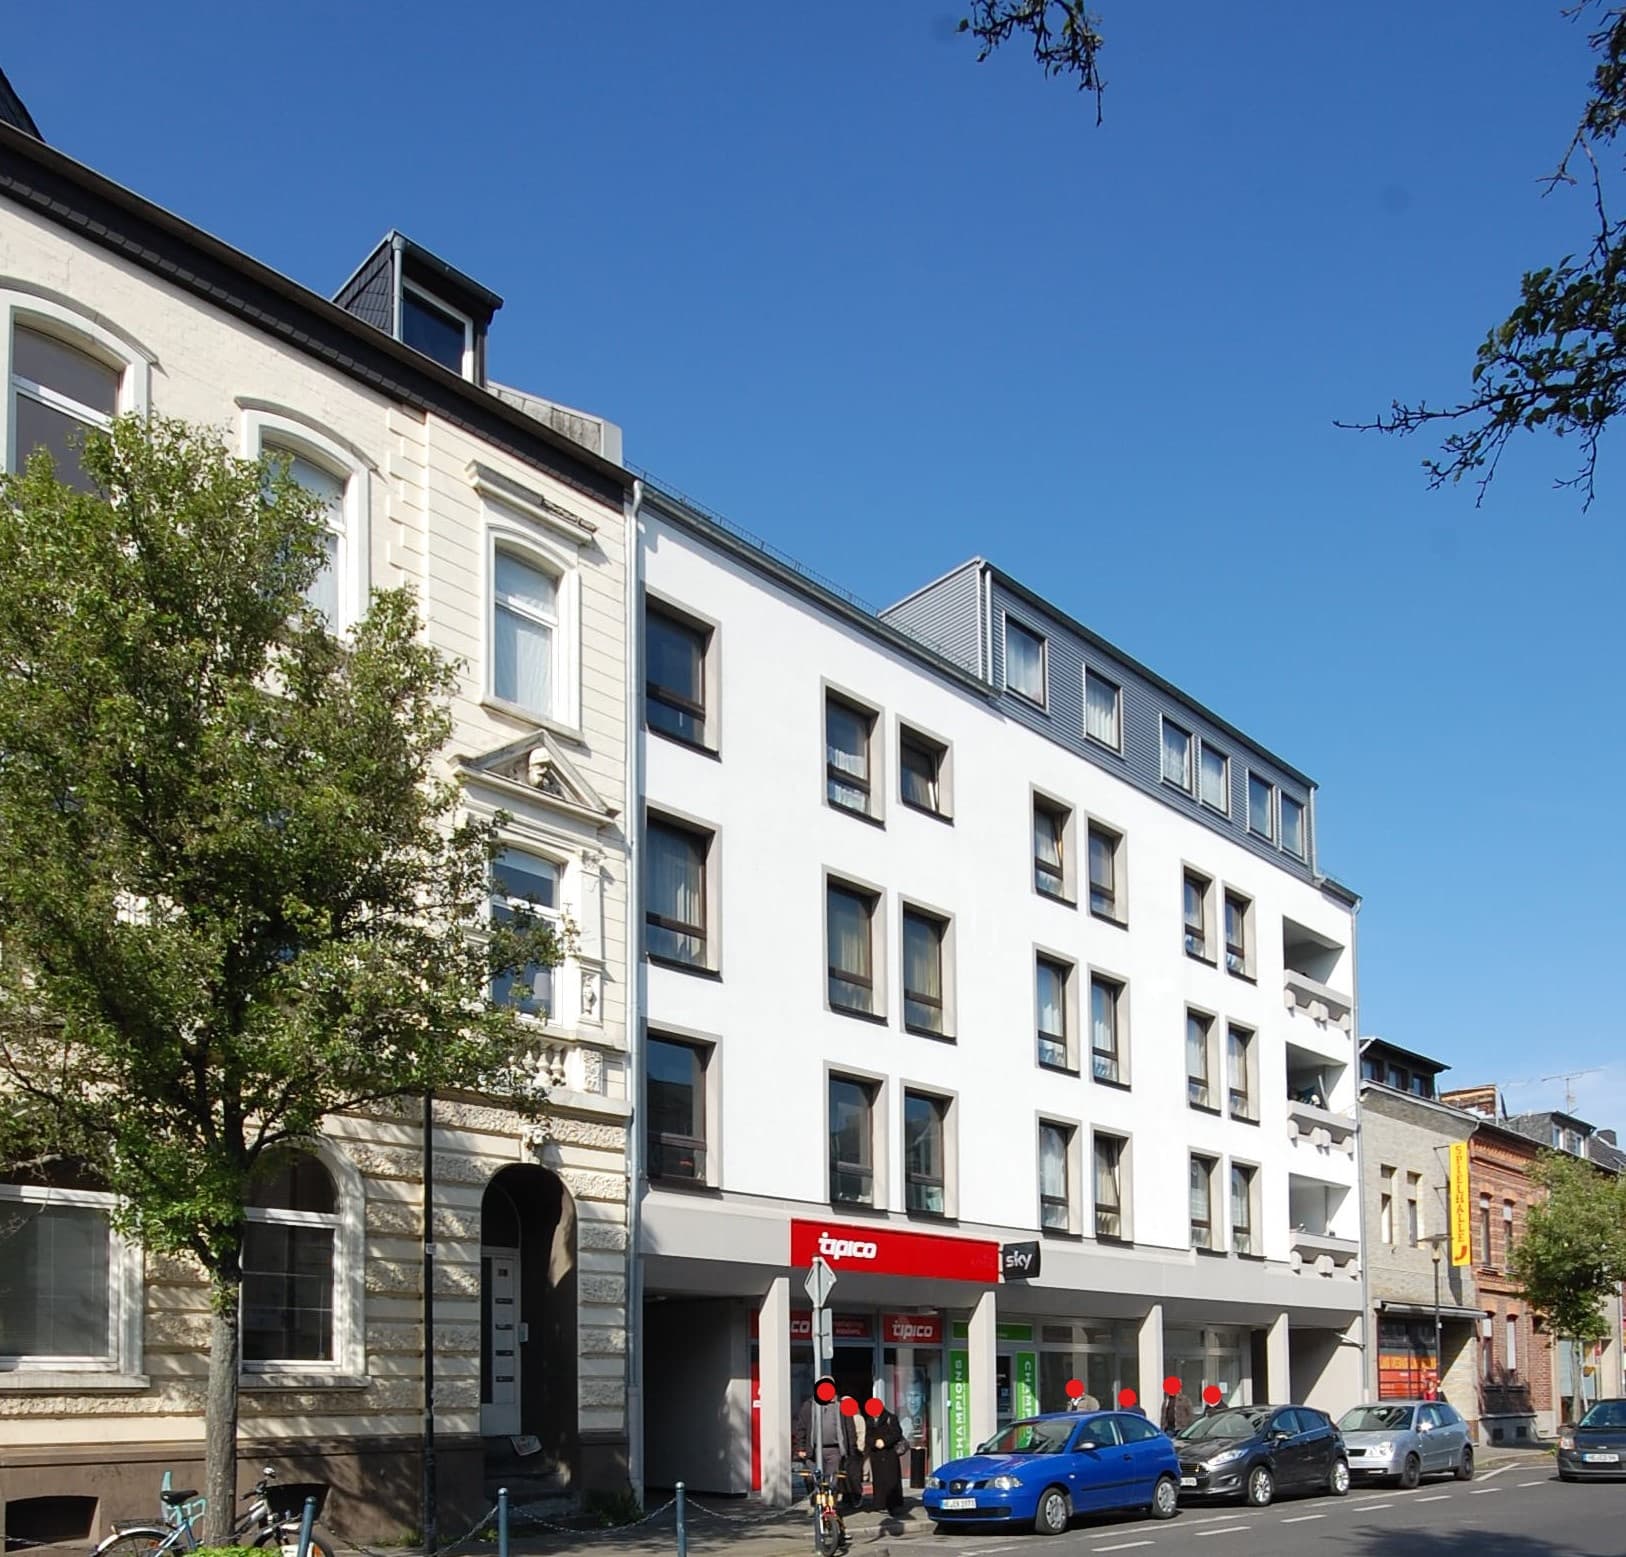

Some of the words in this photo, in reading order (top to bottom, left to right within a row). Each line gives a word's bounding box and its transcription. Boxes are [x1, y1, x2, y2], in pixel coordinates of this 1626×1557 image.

[1455, 1145, 1465, 1243] SPIELHALLE
[818, 1231, 878, 1260] tipico
[1005, 1249, 1033, 1270] sky
[892, 1320, 933, 1340] tipico
[955, 1359, 964, 1459] CHAMPIONS
